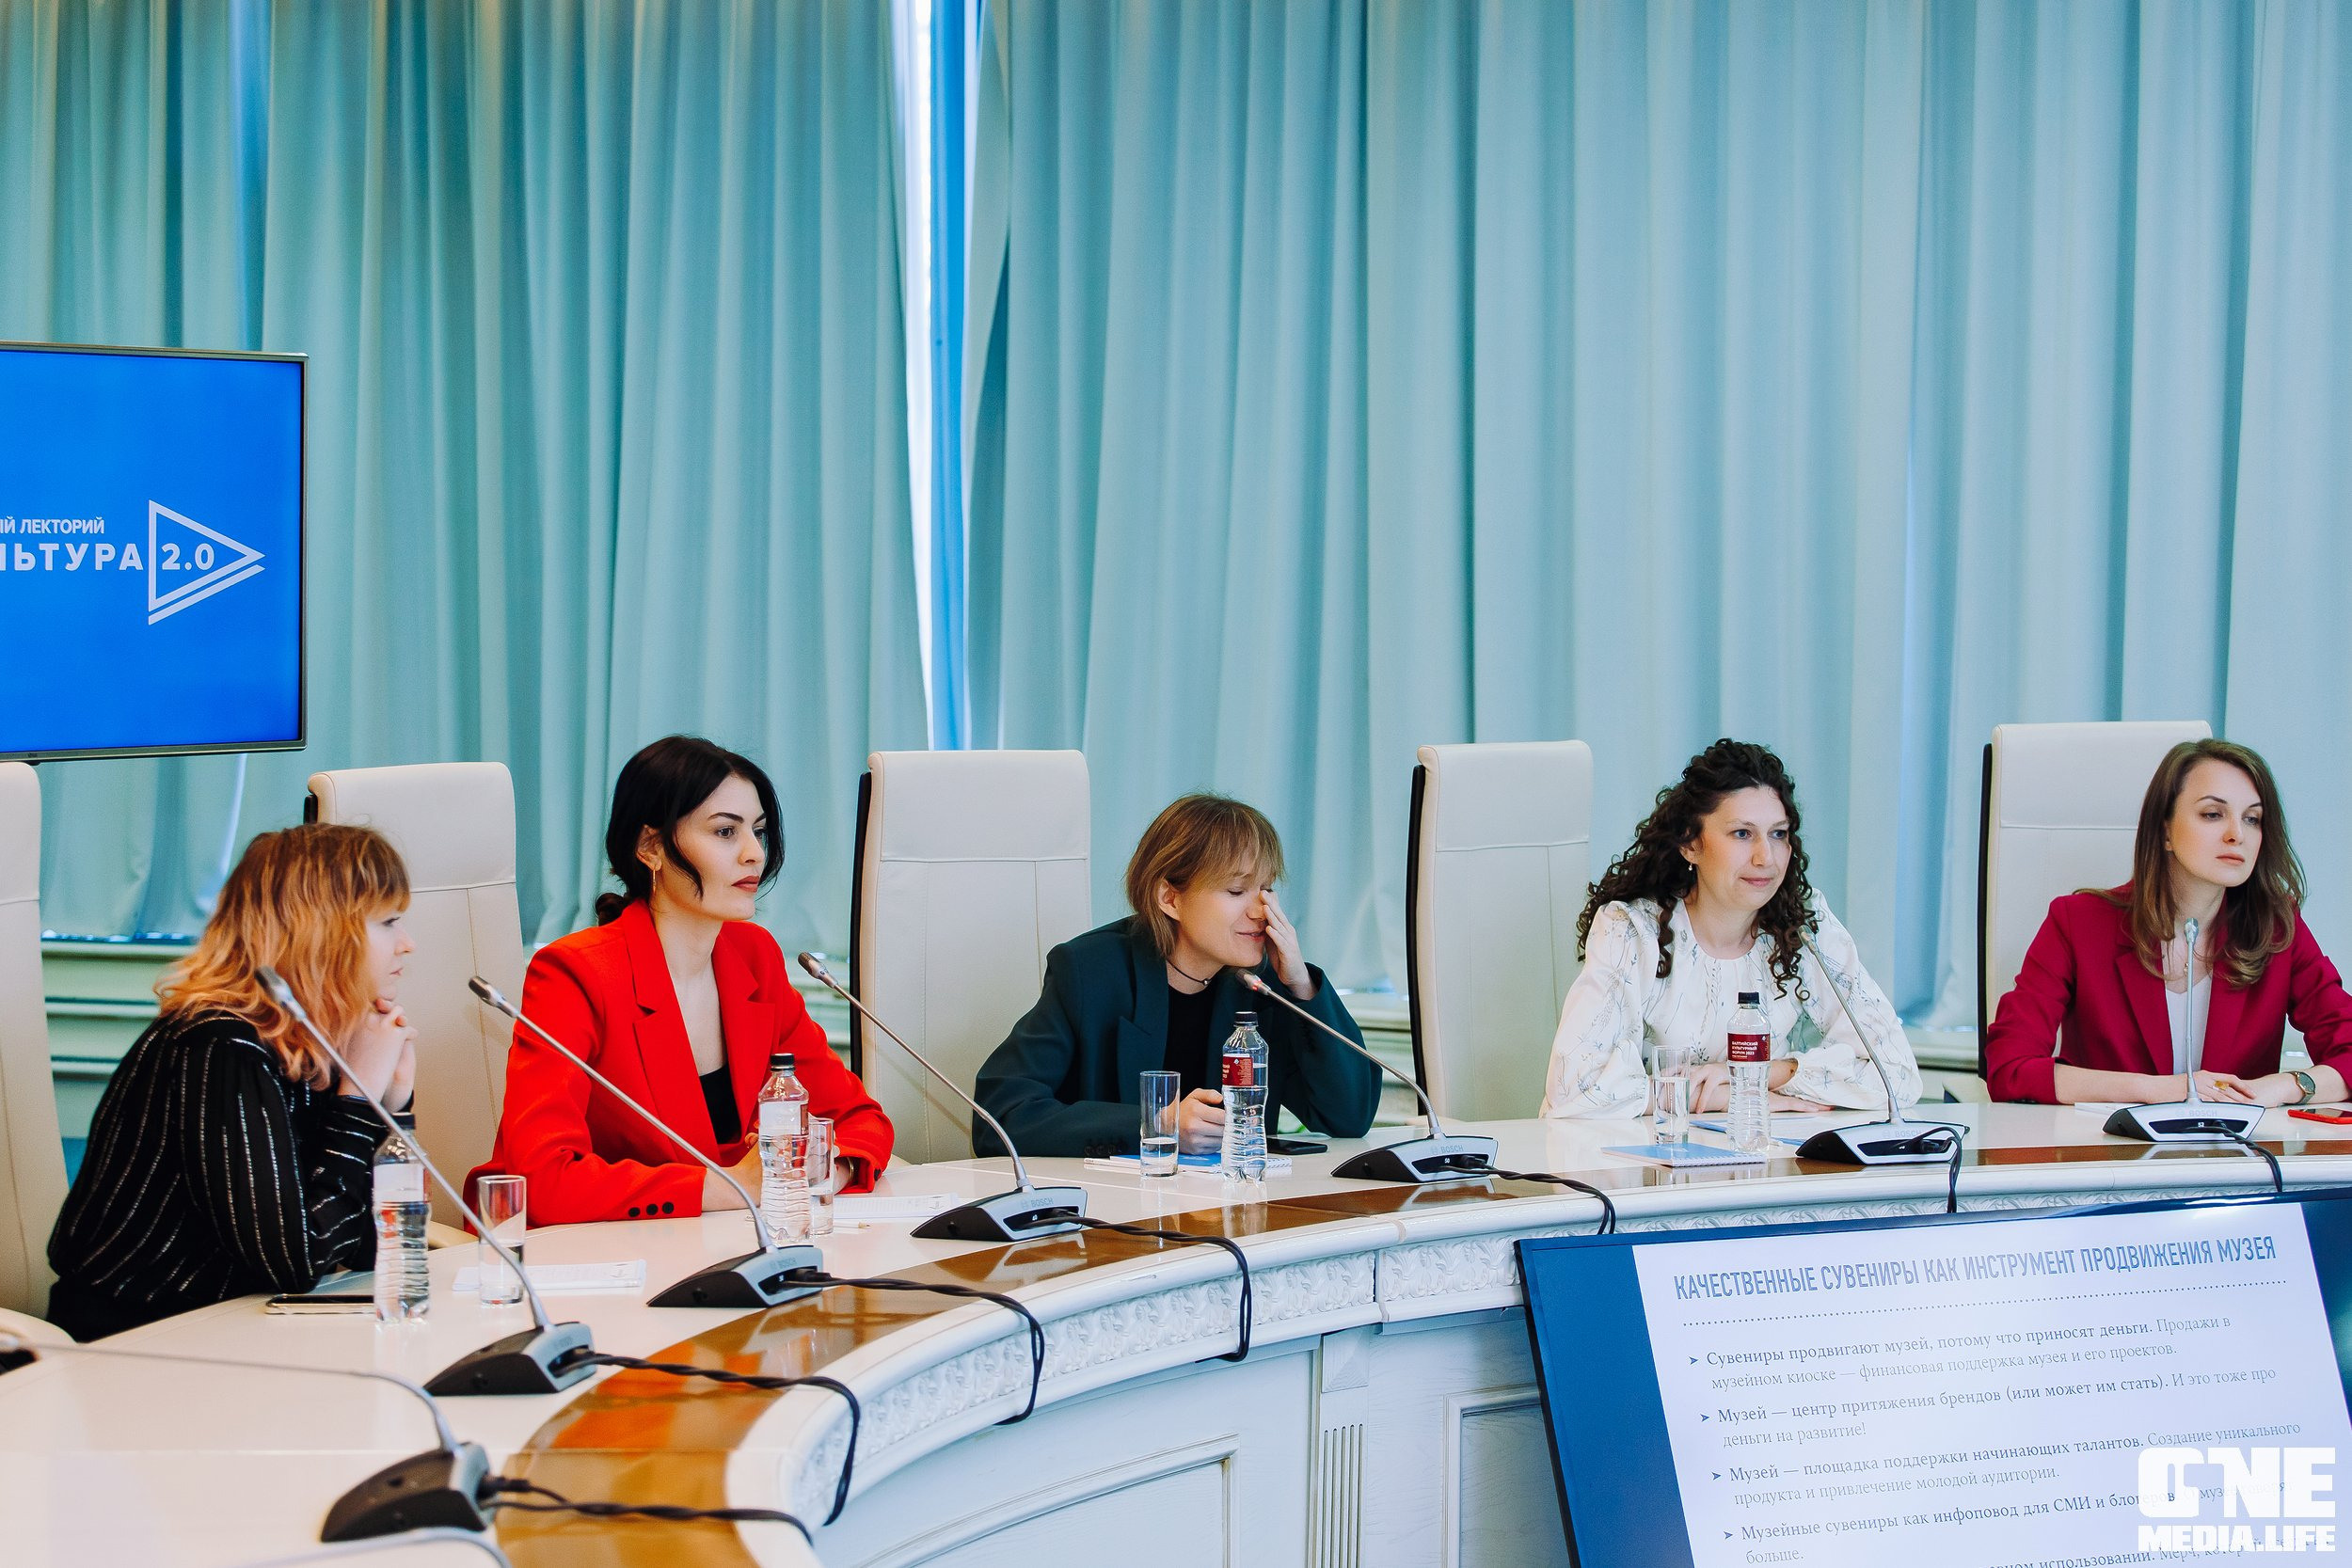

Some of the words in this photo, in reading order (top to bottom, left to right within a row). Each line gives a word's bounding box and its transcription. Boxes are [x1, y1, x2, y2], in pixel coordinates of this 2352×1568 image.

[20, 516, 105, 534] ЛЕКТОРИЙ
[161, 542, 215, 571] 2.0
[2189, 1109, 2217, 1117] BOSCH
[1440, 1144, 1464, 1154] BOSCH
[1030, 1196, 1054, 1208] BOSCH
[1673, 1266, 1818, 1299] КАЧЕСТВЕННЫЕ
[1820, 1259, 1919, 1290] СУВЕНИРЫ
[1922, 1257, 1960, 1283] КАК
[1962, 1249, 2075, 1280] ИНСТРУМЕНТ
[2079, 1240, 2213, 1273] ПРОДВИЖЕНИЯ
[2215, 1235, 2276, 1262] МУЗЕЯ
[1706, 1350, 1784, 1369] Сувениры
[1788, 1343, 1879, 1362] продвигают
[1883, 1336, 1932, 1355] музей,
[1936, 1335, 1991, 1349] потому
[1995, 1332, 2021, 1343] что
[2025, 1327, 2094, 1345] приносят
[2099, 1323, 2152, 1338] деньги.
[2155, 1318, 2218, 1335] Продажи
[2222, 1317, 2230, 1326] в
[1710, 1372, 1783, 1392] музейном
[1786, 1370, 1836, 1383] киоске
[1859, 1362, 1944, 1382] финансовая
[1947, 1355, 2025, 1372] поддержка
[2026, 1353, 2067, 1368] музея
[2071, 1352, 2080, 1361] и
[2084, 1350, 2106, 1360] его
[2109, 1344, 2176, 1362] проектов.
[1716, 1404, 1767, 1425] Музей
[1790, 1404, 1836, 1418] центр
[1840, 1396, 1935, 1416] притяжения
[1939, 1390, 2000, 1408] брендов
[2006, 1385, 2040, 1402] (или
[2044, 1384, 2091, 1397] может
[2095, 1382, 2116, 1392] им
[2120, 1373, 2168, 1390] стать).
[2170, 1372, 2185, 1386] И
[2187, 1374, 2210, 1385] это
[2213, 1370, 2247, 1383] тоже
[2250, 1369, 2276, 1384] про
[1723, 1433, 1772, 1449] деньги
[1775, 1431, 1793, 1442] на
[1797, 1421, 1866, 1445] развитие!
[1728, 1464, 1779, 1483] Музей
[1803, 1459, 1879, 1475] площадка
[1883, 1451, 1968, 1468] поддержки
[1972, 1443, 2070, 1461] начинающих
[2073, 1437, 2143, 1451] талантов.
[2147, 1431, 2212, 1448] Создание
[2215, 1423, 2300, 1444] уникального
[1734, 1489, 1802, 1508] продукта
[1805, 1488, 1815, 1498] и
[1819, 1480, 1912, 1500] привлечение
[1915, 1471, 1978, 1489] молодой
[1980, 1467, 2059, 1486] аудитории.
[1740, 1522, 1820, 1543] Музейные
[1825, 1516, 1899, 1535] сувениры
[1902, 1513, 1929, 1525] как
[1932, 1506, 2019, 1525] инфоповод
[2023, 1503, 2049, 1517] для
[2053, 1496, 2091, 1512] СМИ
[2094, 1498, 2105, 1508] и
[1745, 1549, 1804, 1563] больше.
